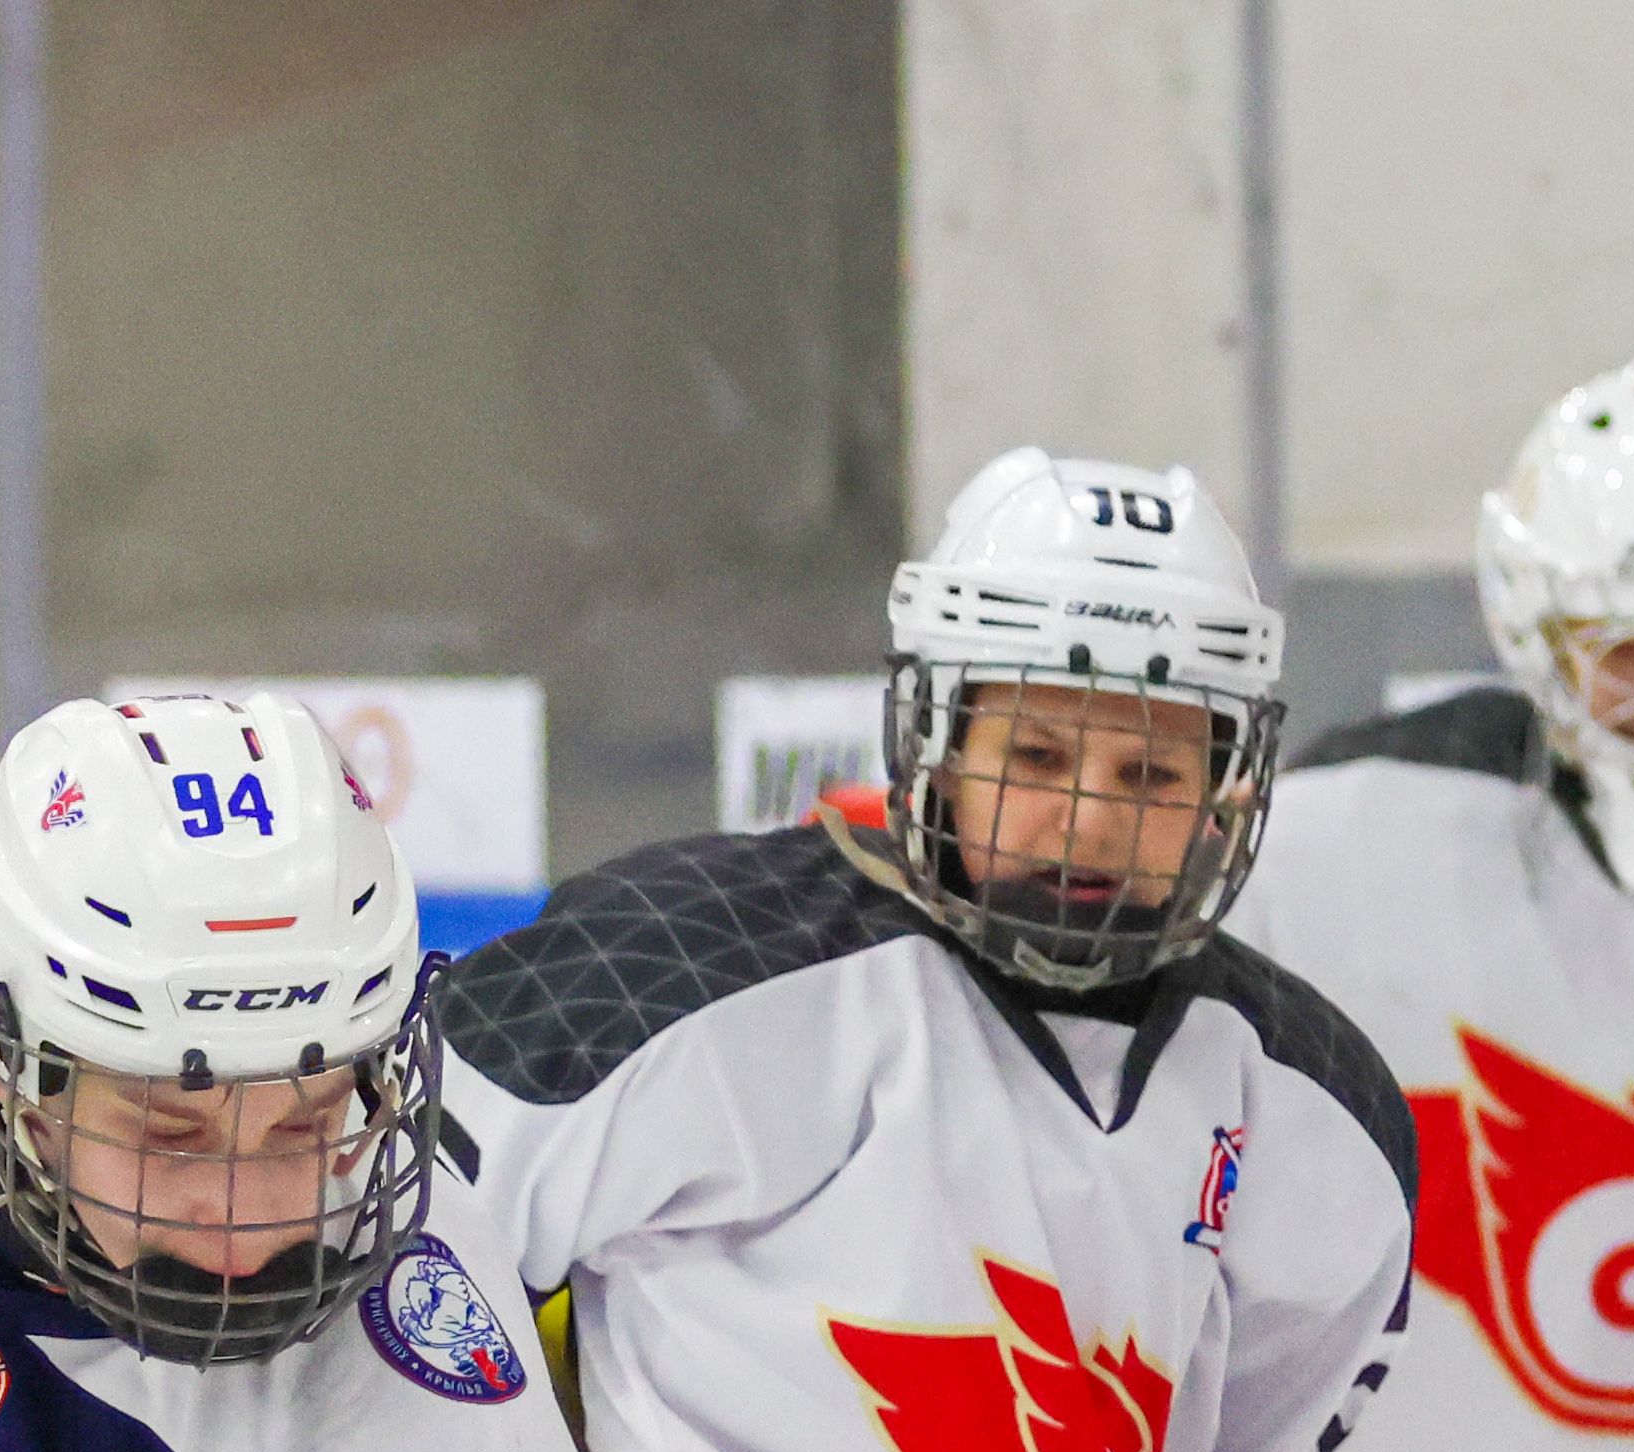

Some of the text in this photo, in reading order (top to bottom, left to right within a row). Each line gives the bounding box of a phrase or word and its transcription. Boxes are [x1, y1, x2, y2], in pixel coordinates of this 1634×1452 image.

[1085, 487, 1174, 534] 10
[172, 774, 274, 838] 94
[183, 981, 330, 1011] CCM
